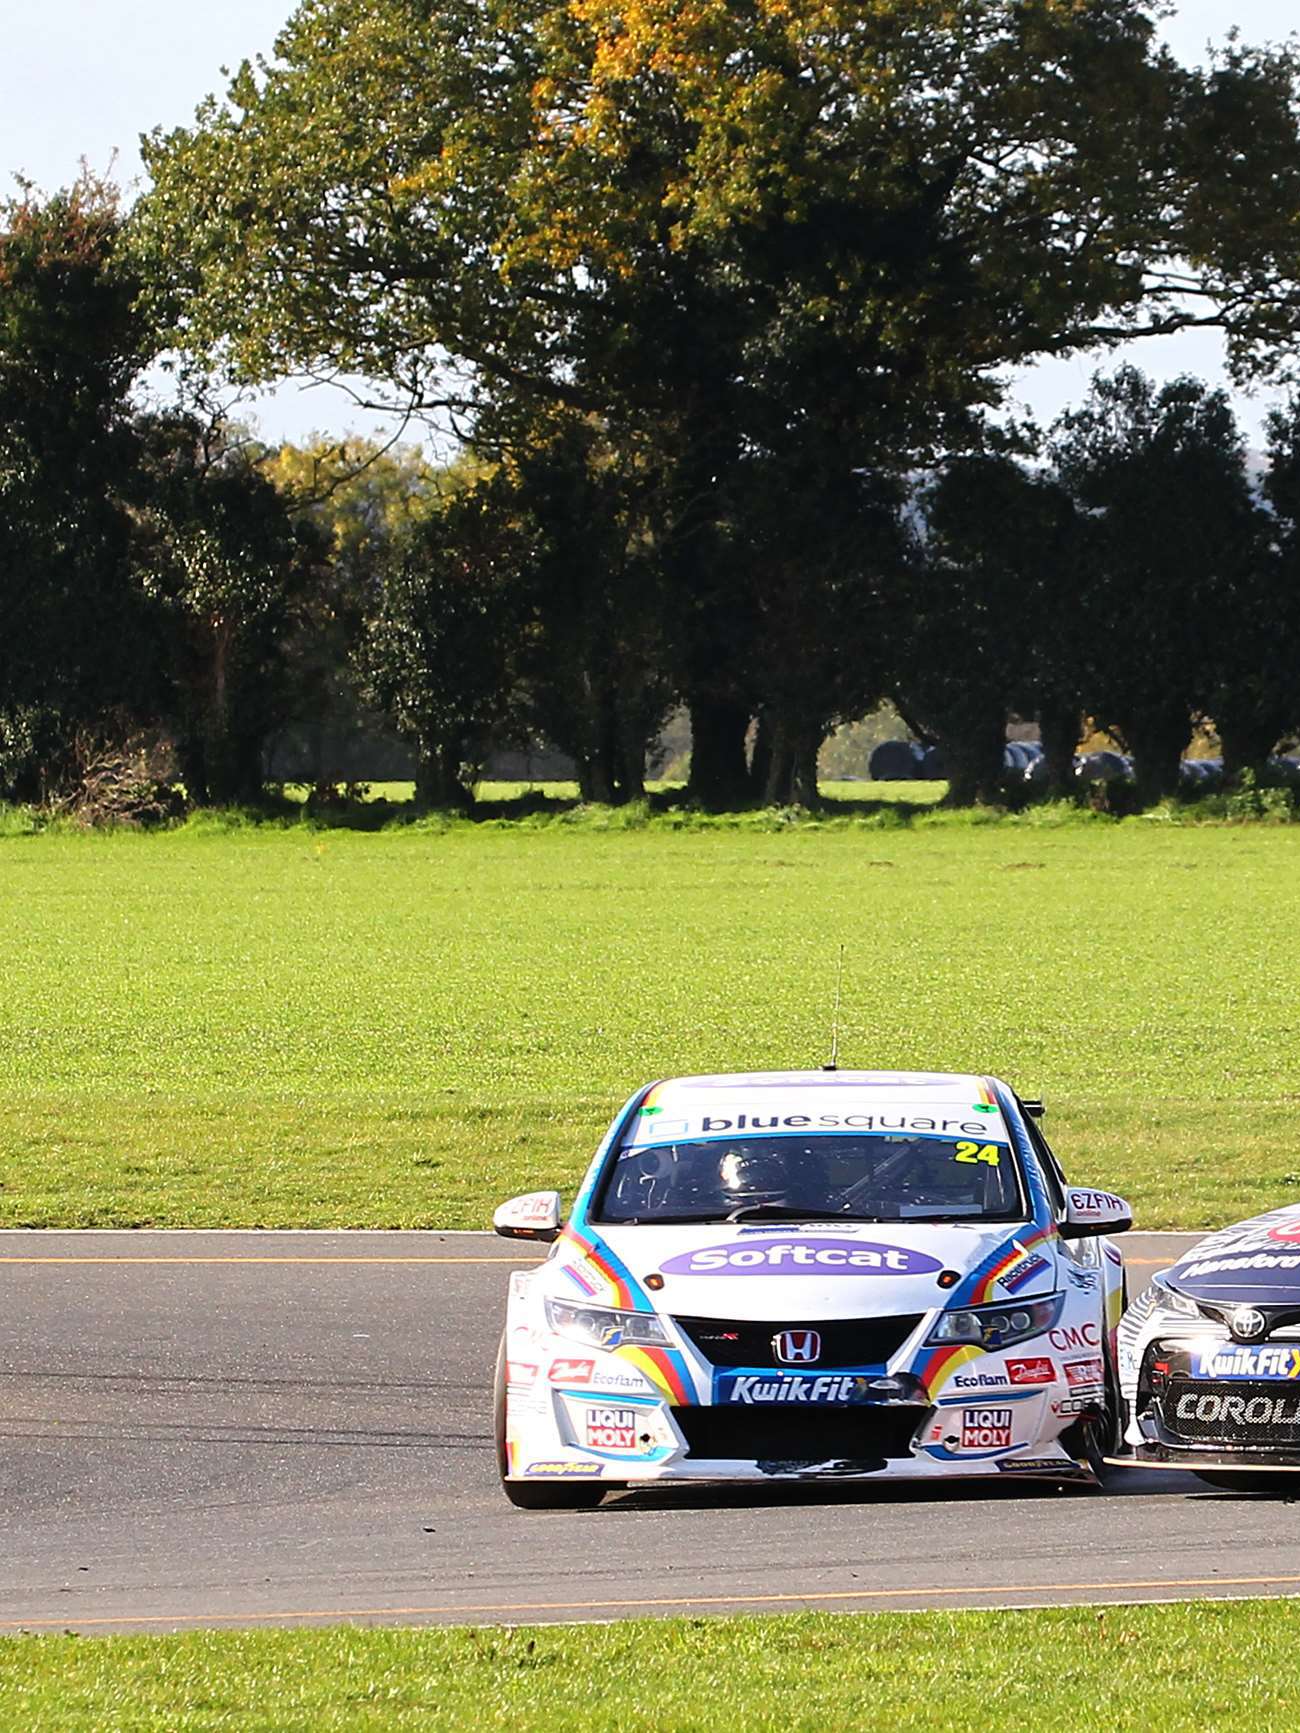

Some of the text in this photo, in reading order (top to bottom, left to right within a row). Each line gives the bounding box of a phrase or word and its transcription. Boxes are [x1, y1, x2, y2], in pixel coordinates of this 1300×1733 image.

[702, 1113, 988, 1136] bluesquare
[954, 1141, 1000, 1166] 24
[689, 1245, 908, 1270] Softcat
[1050, 1323, 1100, 1351] CMC
[588, 1410, 635, 1428] LIQUI
[965, 1411, 1011, 1428] LIQUI
[588, 1428, 635, 1447] MOLY
[964, 1429, 1011, 1447] MOLY
